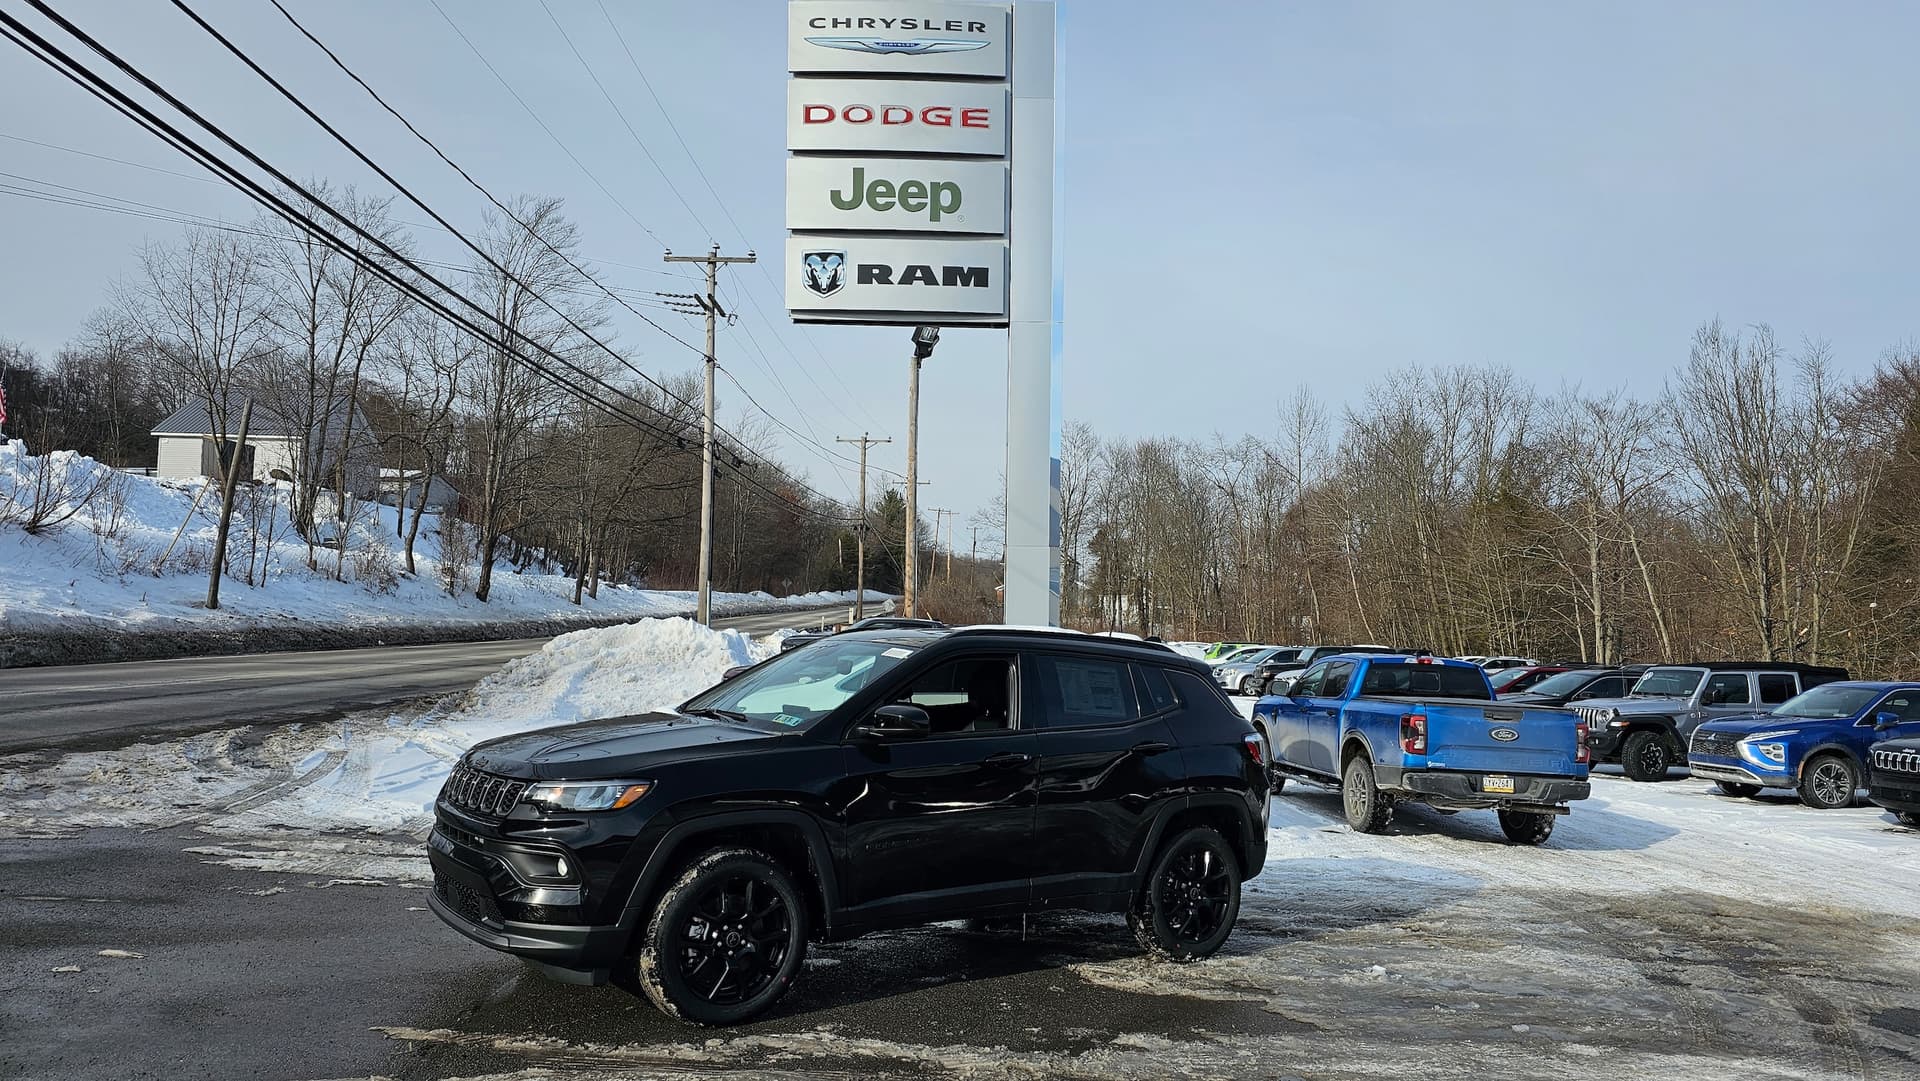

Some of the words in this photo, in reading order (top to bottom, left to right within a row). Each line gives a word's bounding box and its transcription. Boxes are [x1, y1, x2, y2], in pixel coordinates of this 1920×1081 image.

[808, 17, 987, 33] CHRYSLER
[803, 104, 991, 129] DODGE
[829, 167, 962, 222] Jeep
[858, 263, 989, 288] RAM
